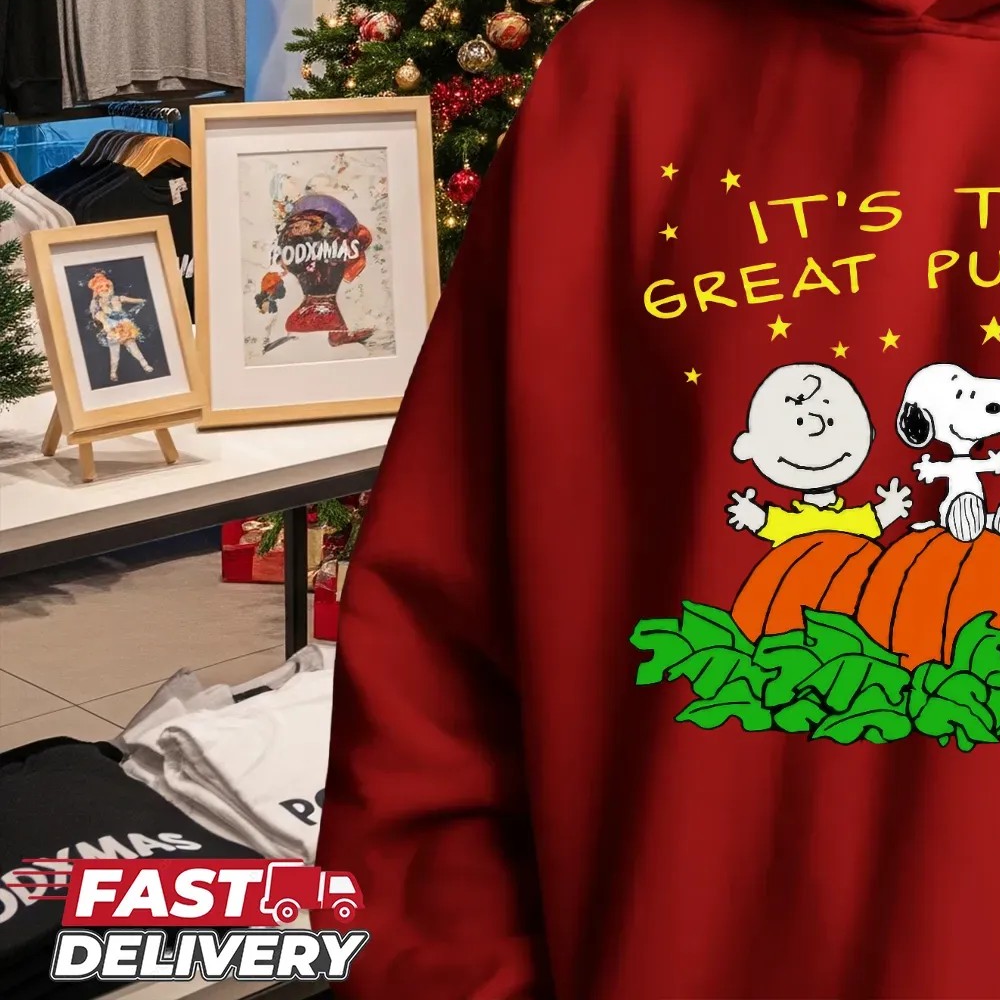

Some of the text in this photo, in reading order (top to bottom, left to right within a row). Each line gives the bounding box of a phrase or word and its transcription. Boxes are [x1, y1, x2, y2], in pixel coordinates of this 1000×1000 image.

[748, 190, 903, 244] IT'S
[269, 238, 360, 267] PODXMAS
[643, 253, 877, 320] GREAT
